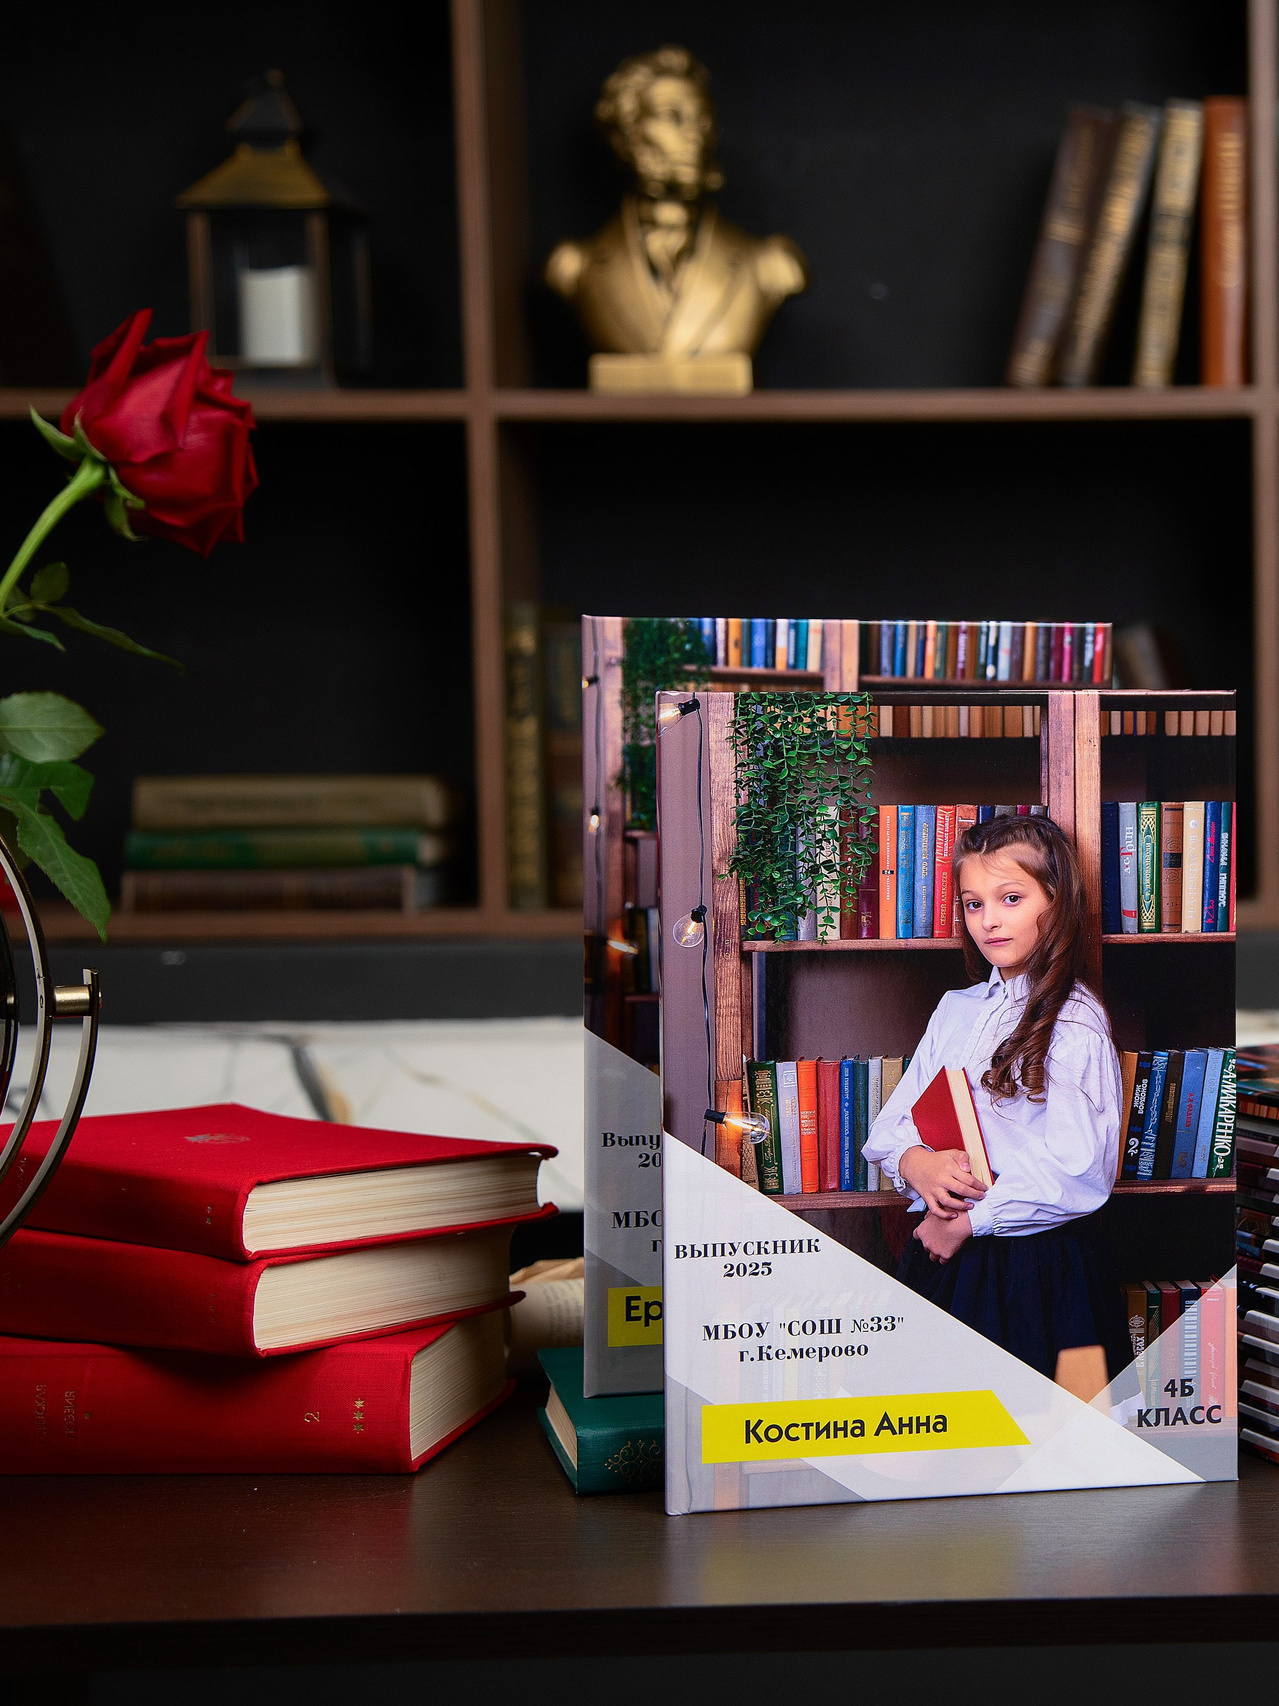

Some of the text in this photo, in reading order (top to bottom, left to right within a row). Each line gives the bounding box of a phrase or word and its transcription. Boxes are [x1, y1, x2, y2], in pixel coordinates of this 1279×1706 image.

[1133, 1084, 1142, 1108] ЖОРЖ
[1137, 1078, 1149, 1115] БОРДОНОВ
[674, 1238, 821, 1259] ВЫПУСКНИК
[723, 1261, 773, 1278] 2025
[702, 1315, 905, 1341] МБОУ "СОШ №33"
[739, 1343, 869, 1363] г.Кемерово
[1163, 1378, 1195, 1398] 4Б
[744, 1411, 948, 1445] Костина Анна
[1136, 1405, 1222, 1428] КЛАСС
